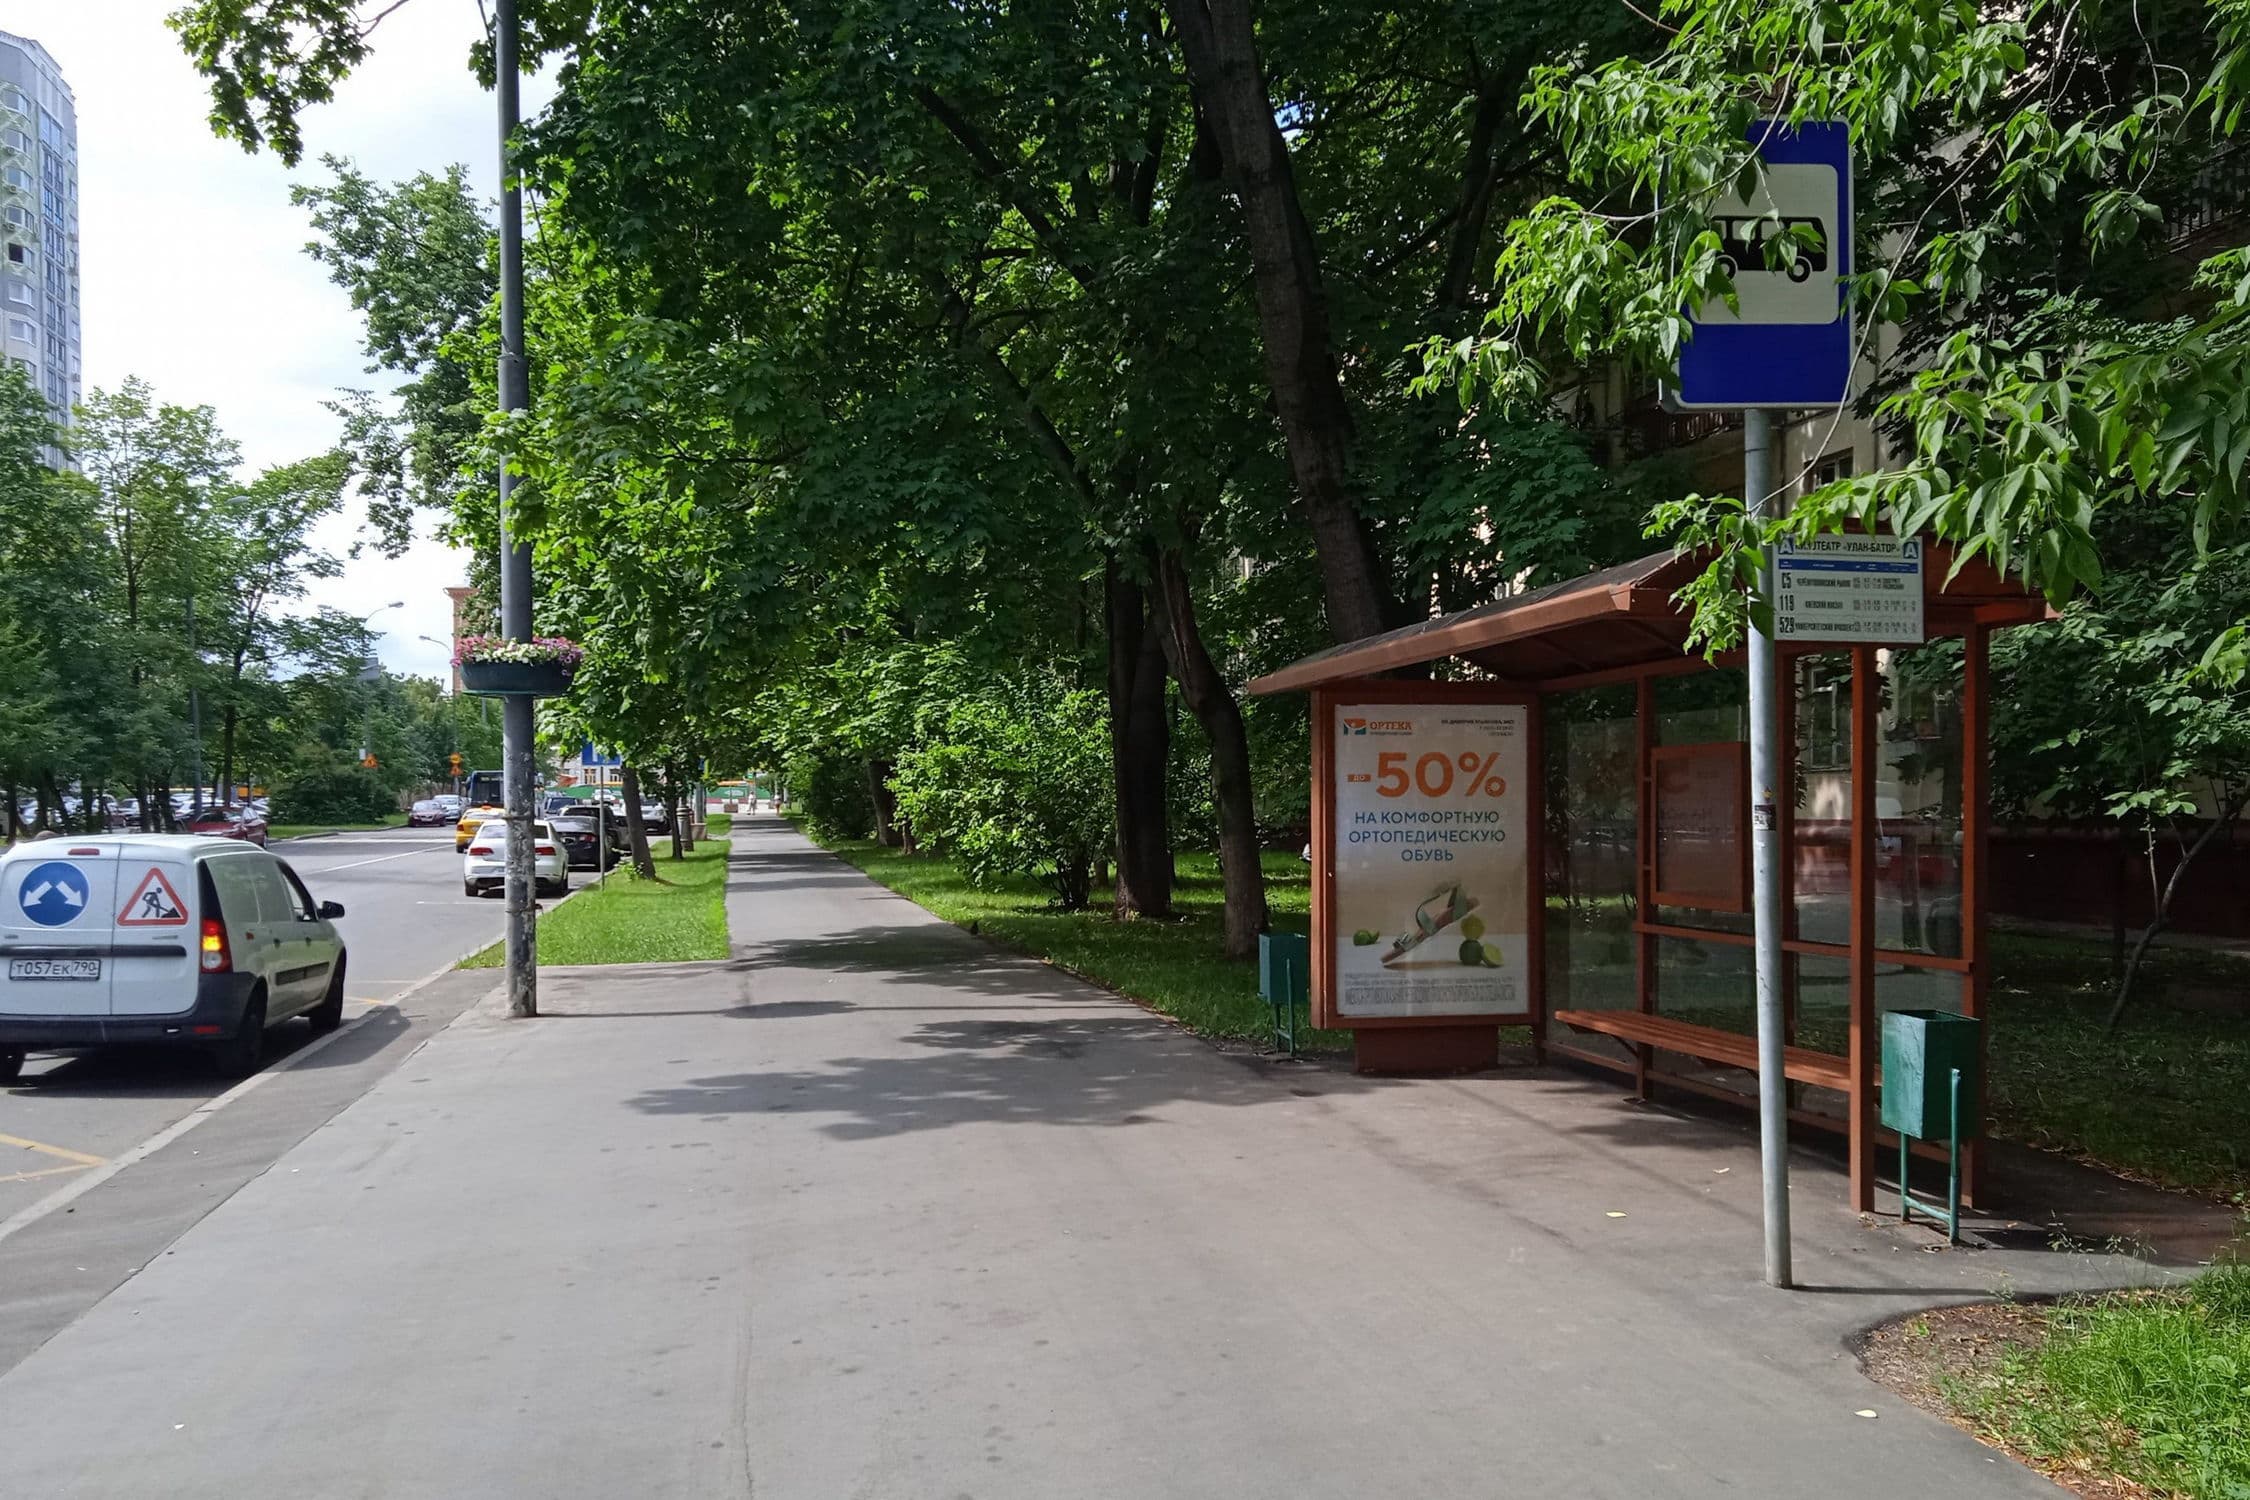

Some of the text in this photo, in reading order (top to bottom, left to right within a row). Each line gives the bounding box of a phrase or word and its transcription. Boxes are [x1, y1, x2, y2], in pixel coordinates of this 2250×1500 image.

[1779, 594, 1795, 611] 119
[1779, 616, 1795, 634] 529
[1370, 721, 1412, 730] ОРТЕКА
[1355, 810, 1500, 824] НА КОМФОРТНУЮ
[1349, 830, 1506, 844] ОРТОПЕДИЧЕСКУЮ
[1401, 849, 1454, 862] ОБУВЬ
